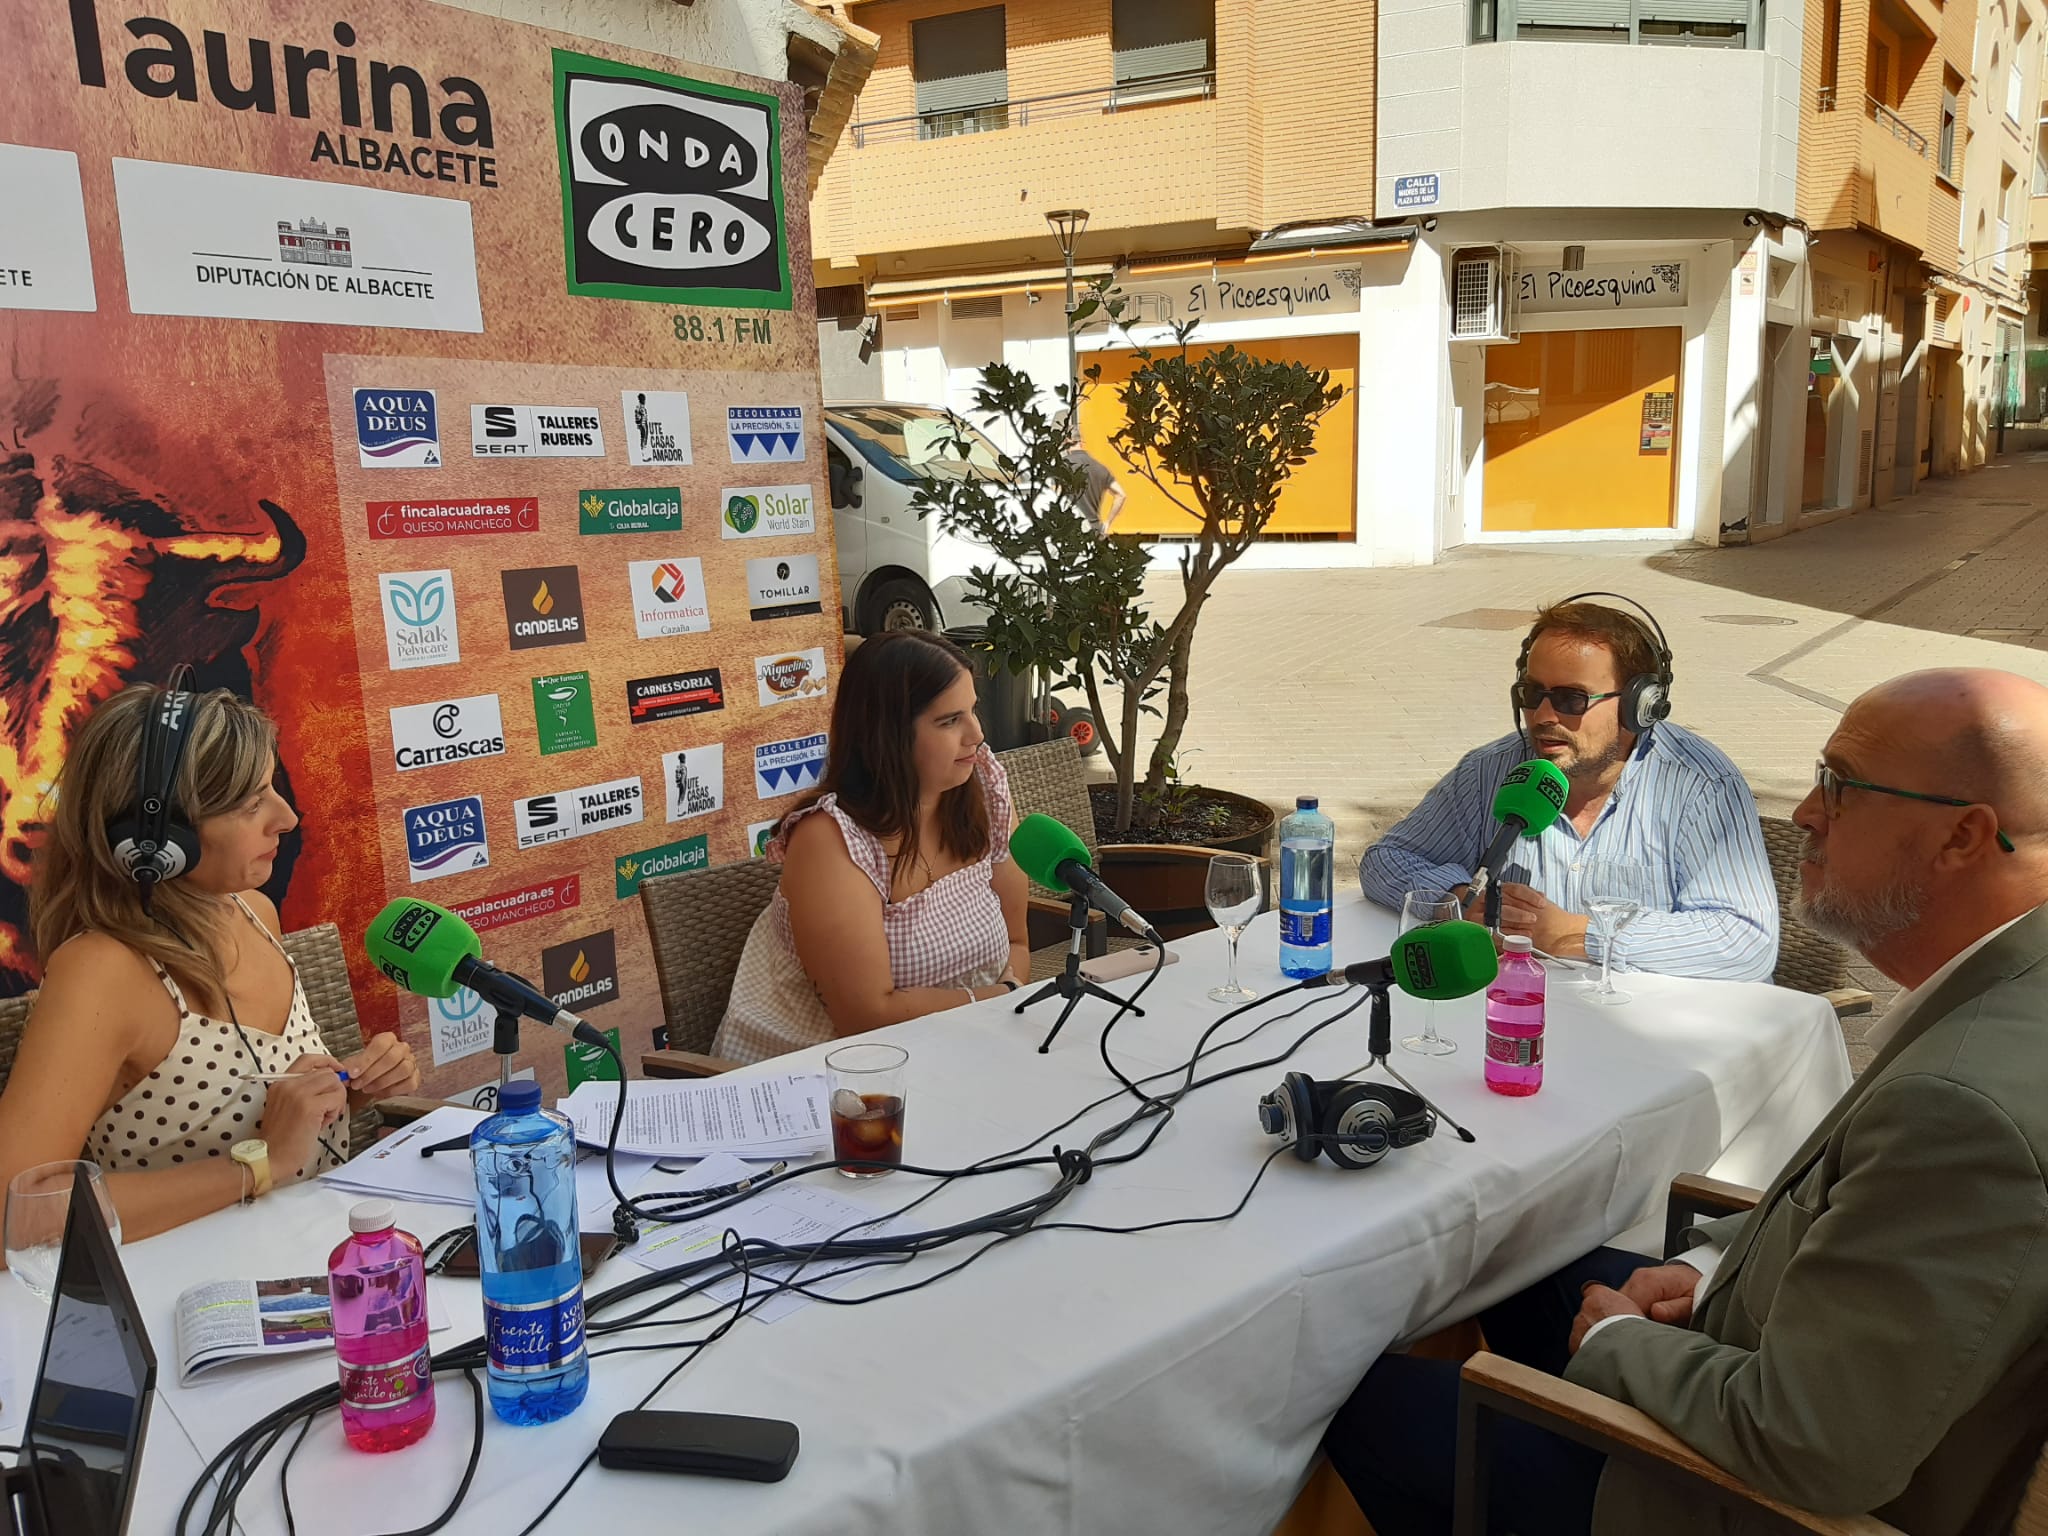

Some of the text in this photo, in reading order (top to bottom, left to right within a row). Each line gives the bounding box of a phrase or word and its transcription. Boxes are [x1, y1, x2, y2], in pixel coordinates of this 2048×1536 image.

[310, 131, 499, 188] ALBACETE
[599, 122, 743, 176] ONDA
[1406, 176, 1435, 188] CALLE
[614, 203, 746, 255] CERO
[196, 265, 436, 301] DIPUTACIÓN DE ALBACETE
[1517, 270, 1657, 306] El Picoesquina
[1187, 277, 1331, 316] El Picoesquina
[672, 314, 772, 345] 88.1 FM
[363, 395, 430, 416] AQUA
[729, 408, 801, 419] DECOLETAJE
[366, 415, 428, 432] DEUS
[537, 414, 599, 431] TALLERES
[649, 421, 663, 436] UTE
[730, 421, 741, 431] LA
[475, 443, 529, 454] SEAT
[540, 432, 593, 447] RUBENS
[650, 435, 675, 449] CASAS
[651, 448, 684, 463] AMADOR
[400, 502, 512, 519] fincalacuadra.es
[608, 497, 679, 520] Globalcaja
[765, 493, 809, 518] Solar
[402, 518, 513, 534] QUESO MANCHEGO
[767, 519, 791, 531] World
[759, 585, 811, 600] TOMILLAR
[640, 605, 705, 623] Informatica
[395, 624, 448, 647] Salak
[514, 616, 579, 637] CANDELAS
[660, 623, 690, 635] Cazaña
[397, 642, 449, 658] Pelvicare
[761, 659, 813, 682] Miguelitos
[636, 682, 673, 697] CARNES
[673, 676, 713, 691] SORIA
[395, 736, 504, 768] Carrascas
[756, 736, 825, 758] DECOLETAJE
[758, 758, 769, 769] LA
[687, 776, 700, 790] UTE
[578, 785, 641, 810] TALLERES
[687, 786, 710, 802] CASAS
[581, 802, 633, 826] RUBENS
[687, 796, 716, 815] AMADOR
[412, 804, 477, 831] AQUA
[416, 822, 476, 848] DEUS
[520, 827, 571, 847] SEAT
[641, 846, 706, 877] Globalcaja
[449, 886, 555, 918] incalacuadra.es
[491, 899, 556, 926] MANCHEGO
[407, 914, 432, 942] CERO
[551, 976, 614, 1007] CANDELAS
[439, 1013, 490, 1042] Salak
[440, 1030, 491, 1054] Pelvicare
[493, 1316, 545, 1337] Fuente
